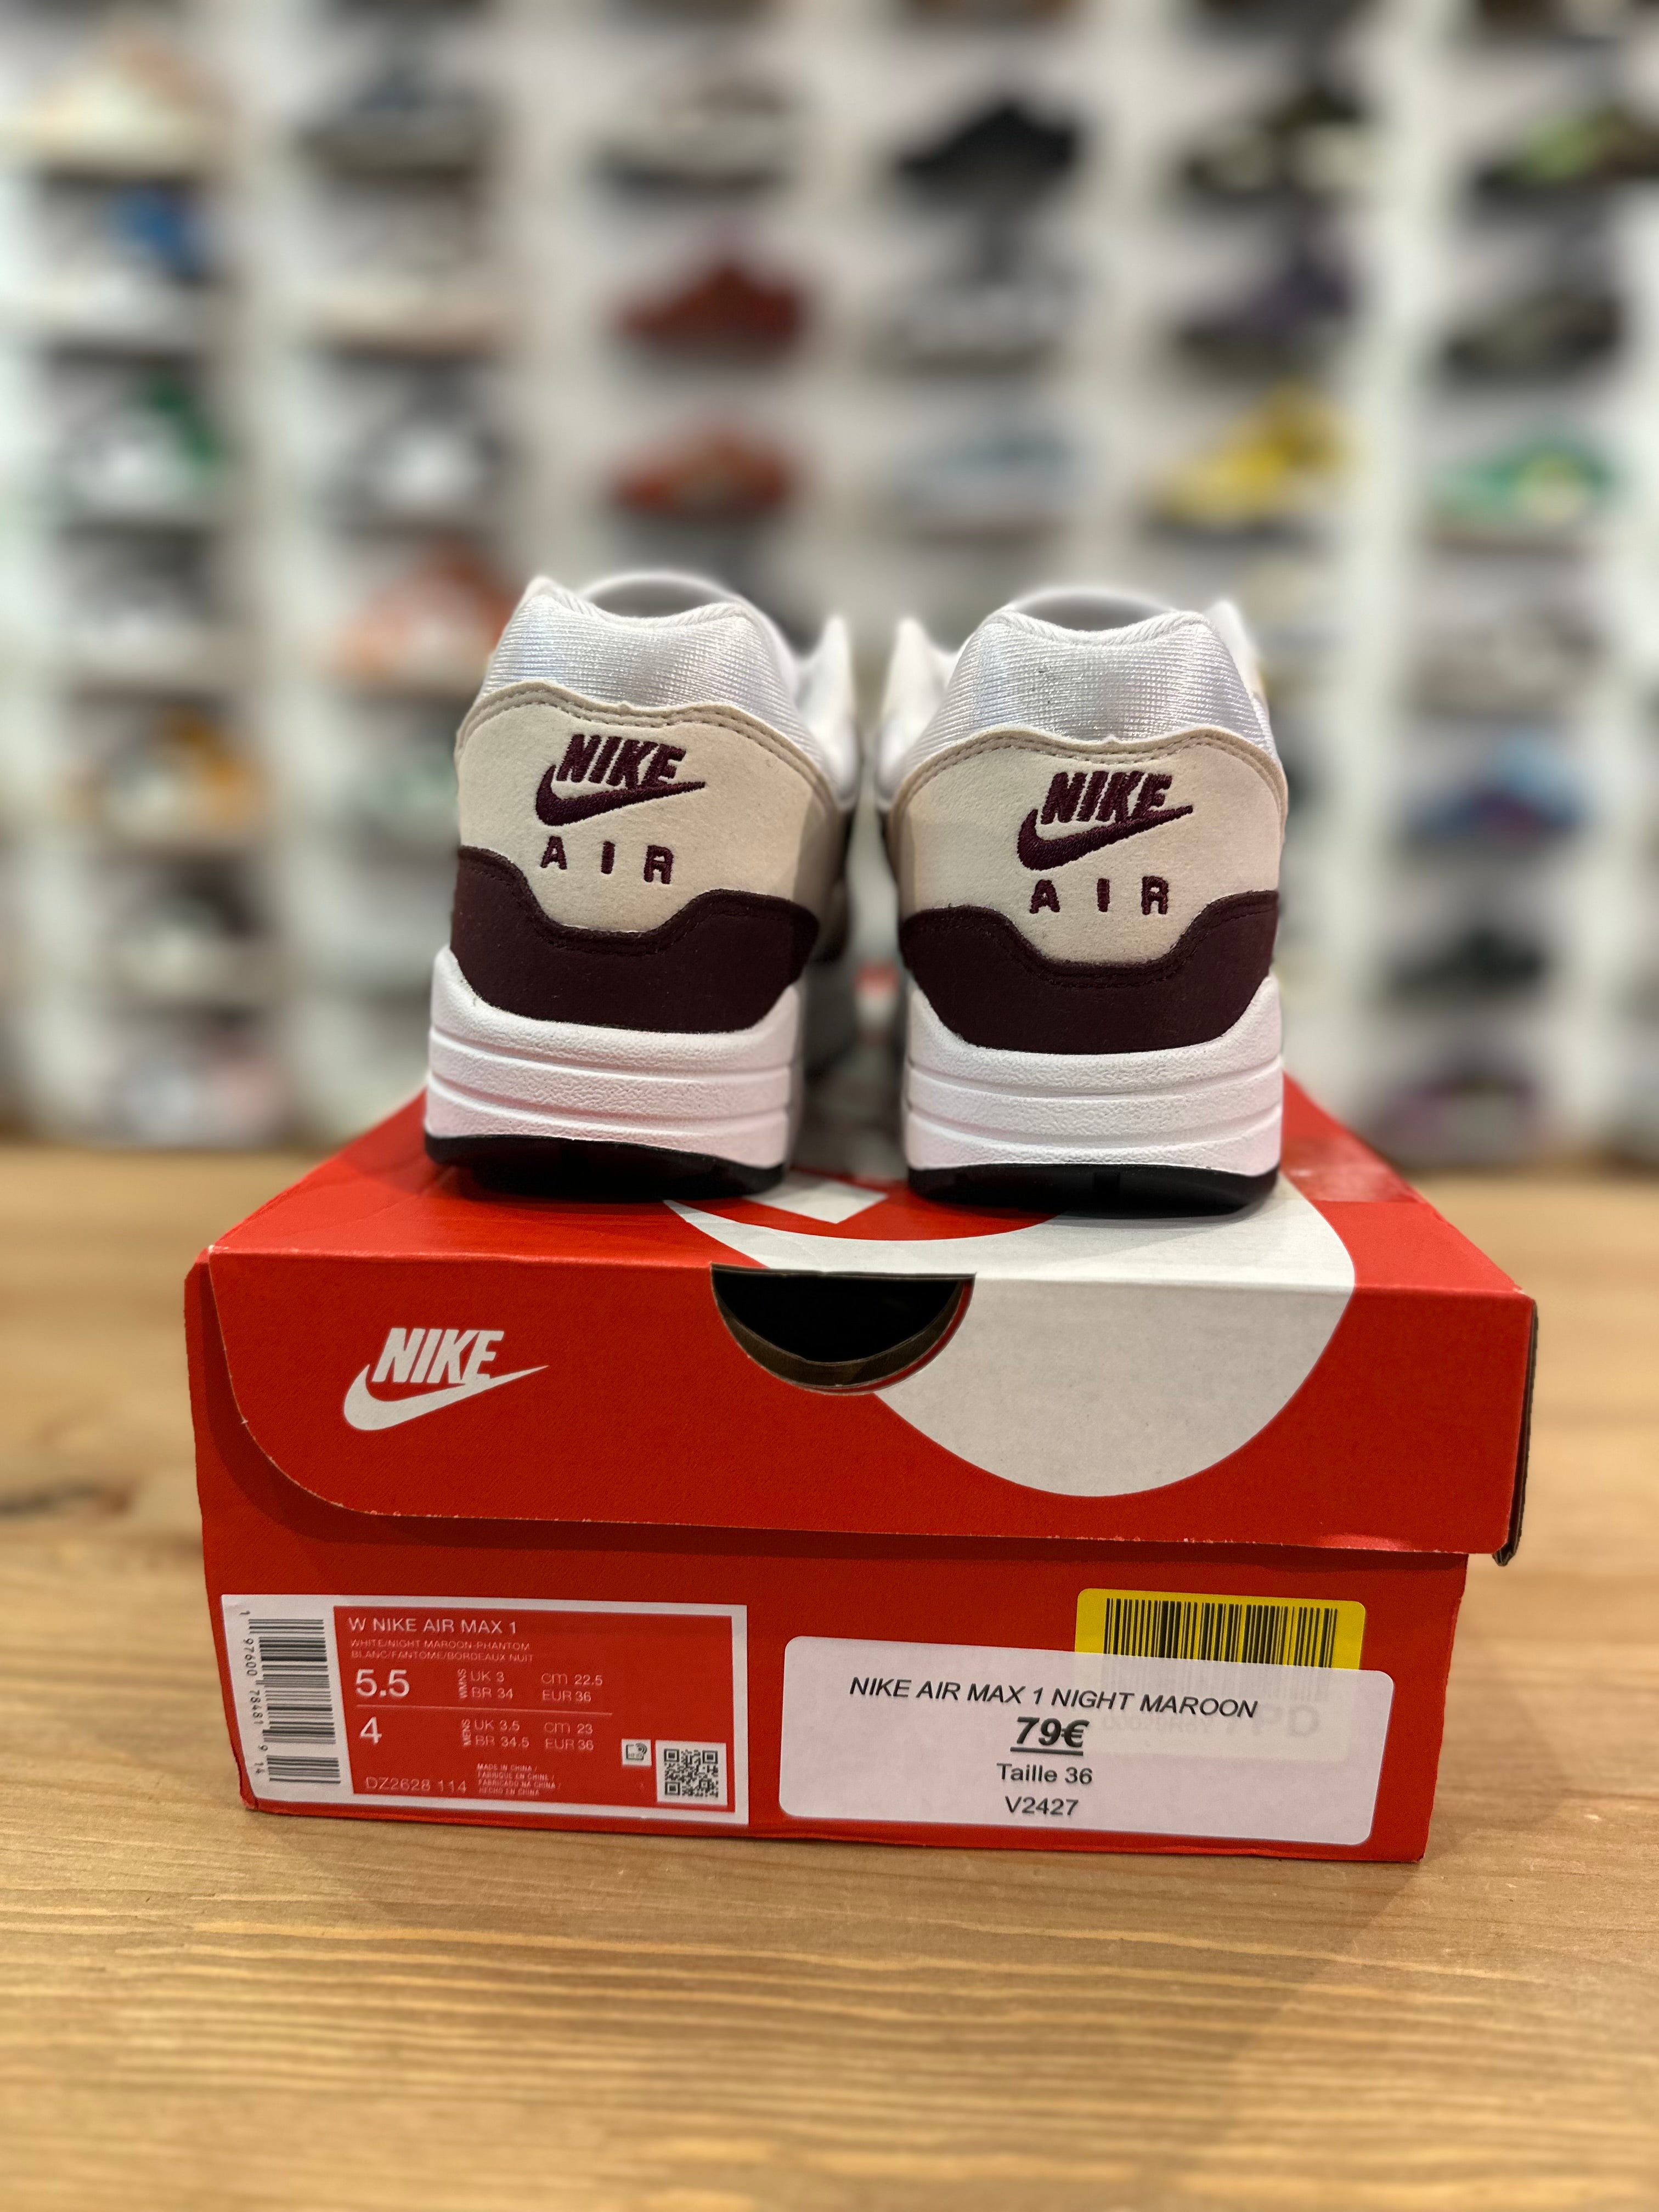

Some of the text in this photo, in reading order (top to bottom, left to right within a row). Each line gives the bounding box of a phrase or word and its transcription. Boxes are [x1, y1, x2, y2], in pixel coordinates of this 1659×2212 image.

[555, 733, 686, 789] NIKE
[1041, 770, 1172, 824] NIKE
[540, 835, 674, 884] AIR
[1029, 876, 1169, 915] AIR
[371, 1327, 505, 1385] NIKE
[348, 1617, 517, 1634] W NIKE AIR MAX 1
[244, 1638, 258, 1677] 97600
[355, 1668, 410, 1698] 5.5
[471, 1671, 505, 1683] UK 3
[574, 1674, 603, 1686] 22.5
[472, 1686, 514, 1700] BR 34
[543, 1689, 591, 1703] EUR 36
[849, 1676, 1259, 1719] NIKE AIR MAX 1 NIGHT MAROON
[249, 1689, 264, 1726] 78481
[359, 1716, 382, 1745] 4
[474, 1719, 520, 1732] UK 3.5
[577, 1723, 593, 1735] 23
[1015, 1716, 1090, 1749] 79€
[475, 1735, 530, 1748] BR 34.5
[545, 1738, 594, 1751] EUR 36
[365, 1776, 467, 1794] DZ2628 114
[997, 1762, 1093, 1785] Taille 36
[1004, 1796, 1080, 1817] V2427
